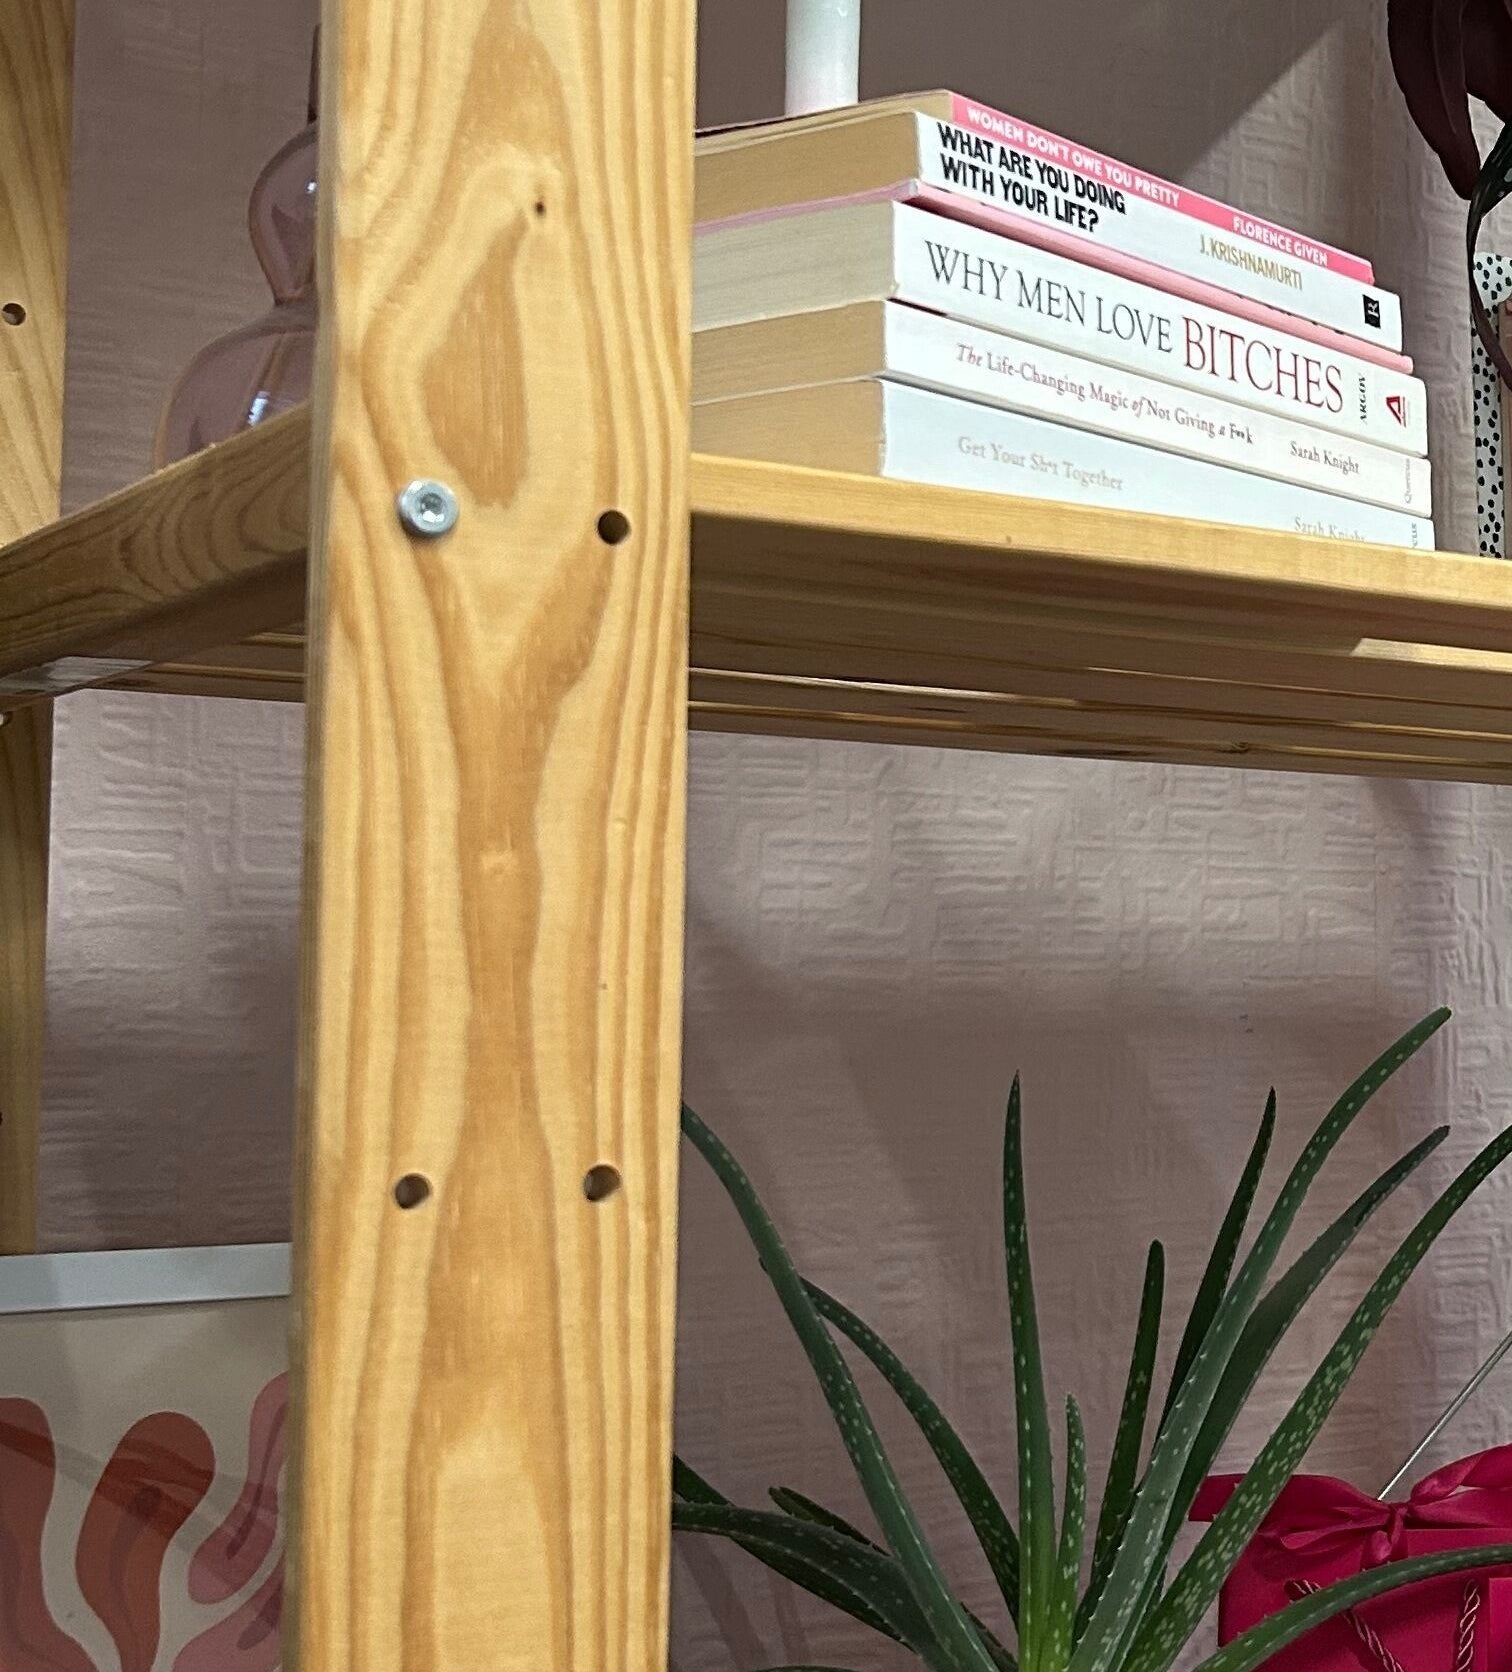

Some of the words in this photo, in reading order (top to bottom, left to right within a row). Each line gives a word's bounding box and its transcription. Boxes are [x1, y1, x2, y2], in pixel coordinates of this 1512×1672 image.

[937, 122, 994, 164] WHAT
[999, 145, 1033, 180] ARE
[1035, 158, 1070, 193] YOU
[1074, 173, 1127, 215] DOING
[940, 153, 995, 197] WITH
[1000, 175, 1048, 216] YOUR
[1054, 197, 1099, 232] LIFE?
[967, 106, 1025, 143] WOMEN
[1027, 131, 1069, 159] DON'T
[1072, 147, 1102, 172] OWE
[1104, 161, 1132, 187] YOU
[1135, 177, 1180, 207] PRETTY
[1233, 216, 1293, 253] FLORENCE
[1293, 242, 1328, 266] GIVEN
[925, 240, 1008, 301] WHY
[1017, 270, 1086, 326] MEN
[1096, 296, 1173, 353] LOVE
[1182, 316, 1343, 413] BITCHES
[956, 343, 982, 367] The
[987, 352, 1086, 401] Life-Changing
[1090, 382, 1128, 411] Magic
[1132, 396, 1145, 418] of
[1146, 400, 1171, 421] Not
[1175, 408, 1215, 438] Giving
[1218, 425, 1226, 436] a
[958, 436, 985, 459] Get
[989, 443, 1025, 468] Your
[1062, 461, 1123, 490] Together
[1290, 441, 1321, 463] Sarah
[1323, 450, 1359, 475] Knight
